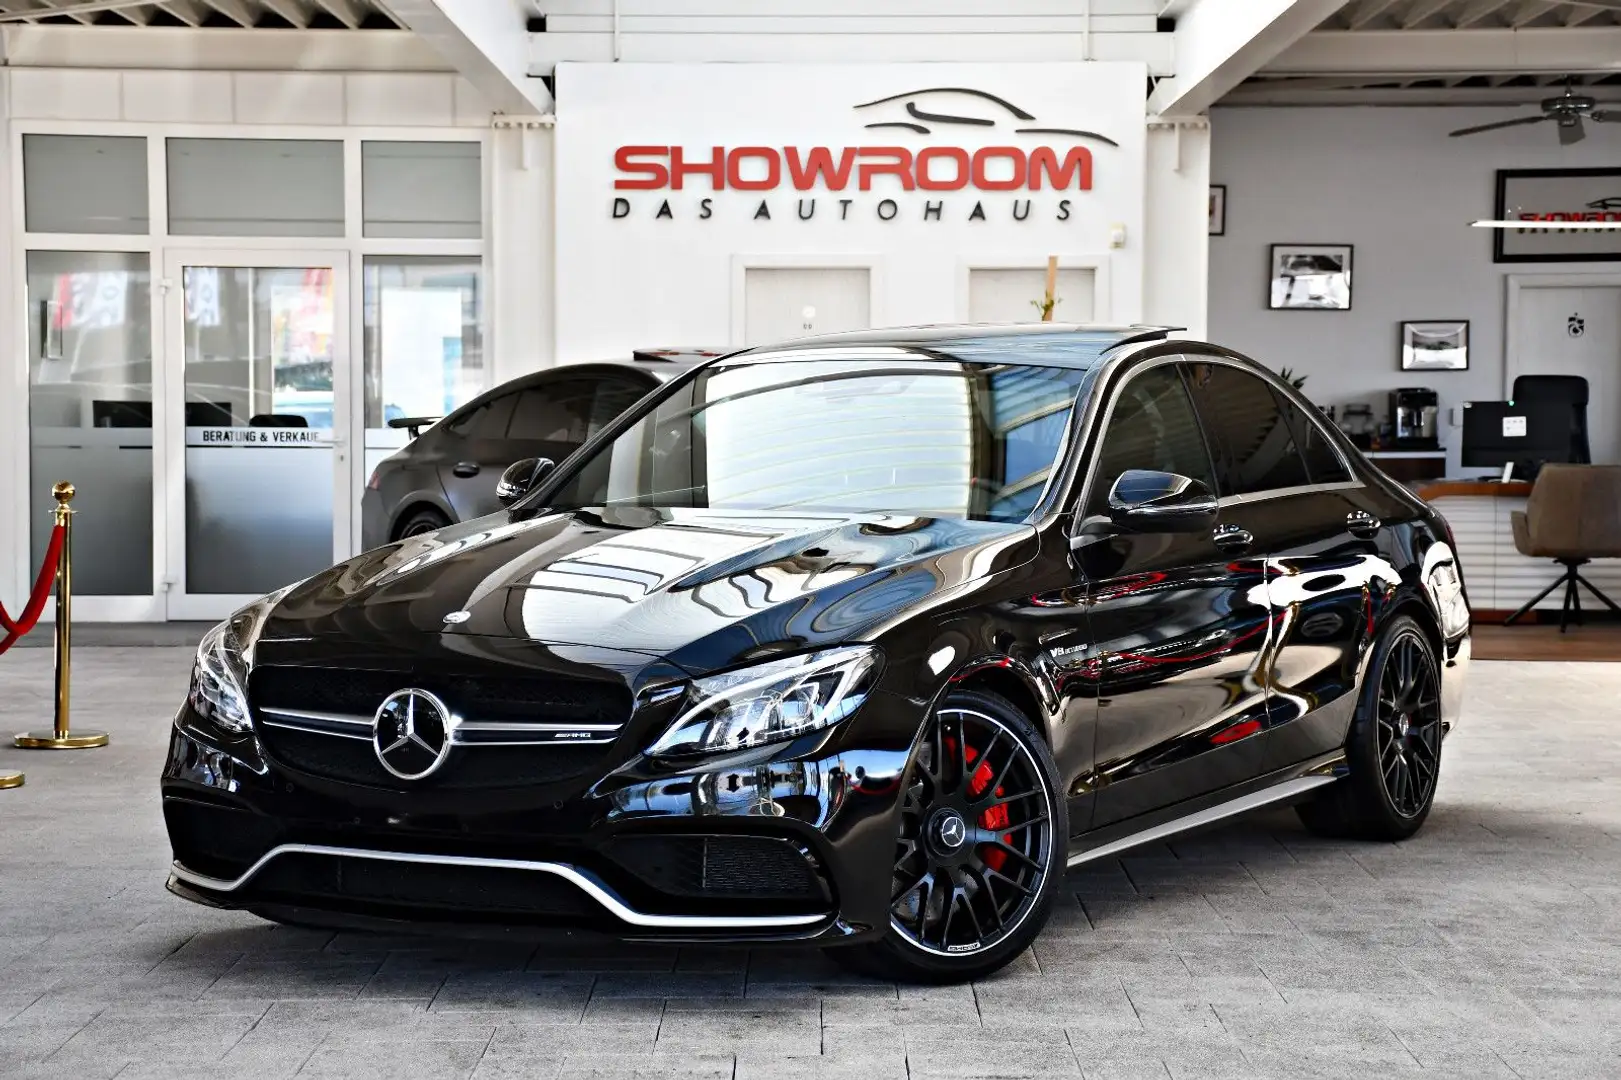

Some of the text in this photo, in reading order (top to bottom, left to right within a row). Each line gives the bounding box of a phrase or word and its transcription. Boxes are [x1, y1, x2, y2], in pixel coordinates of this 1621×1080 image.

[614, 145, 1093, 191] SHOWROOM
[612, 198, 1071, 221] DAS AUTOHAUS
[202, 430, 257, 442] BERATUNG
[260, 431, 268, 442] &
[1050, 647, 1064, 658] V8
